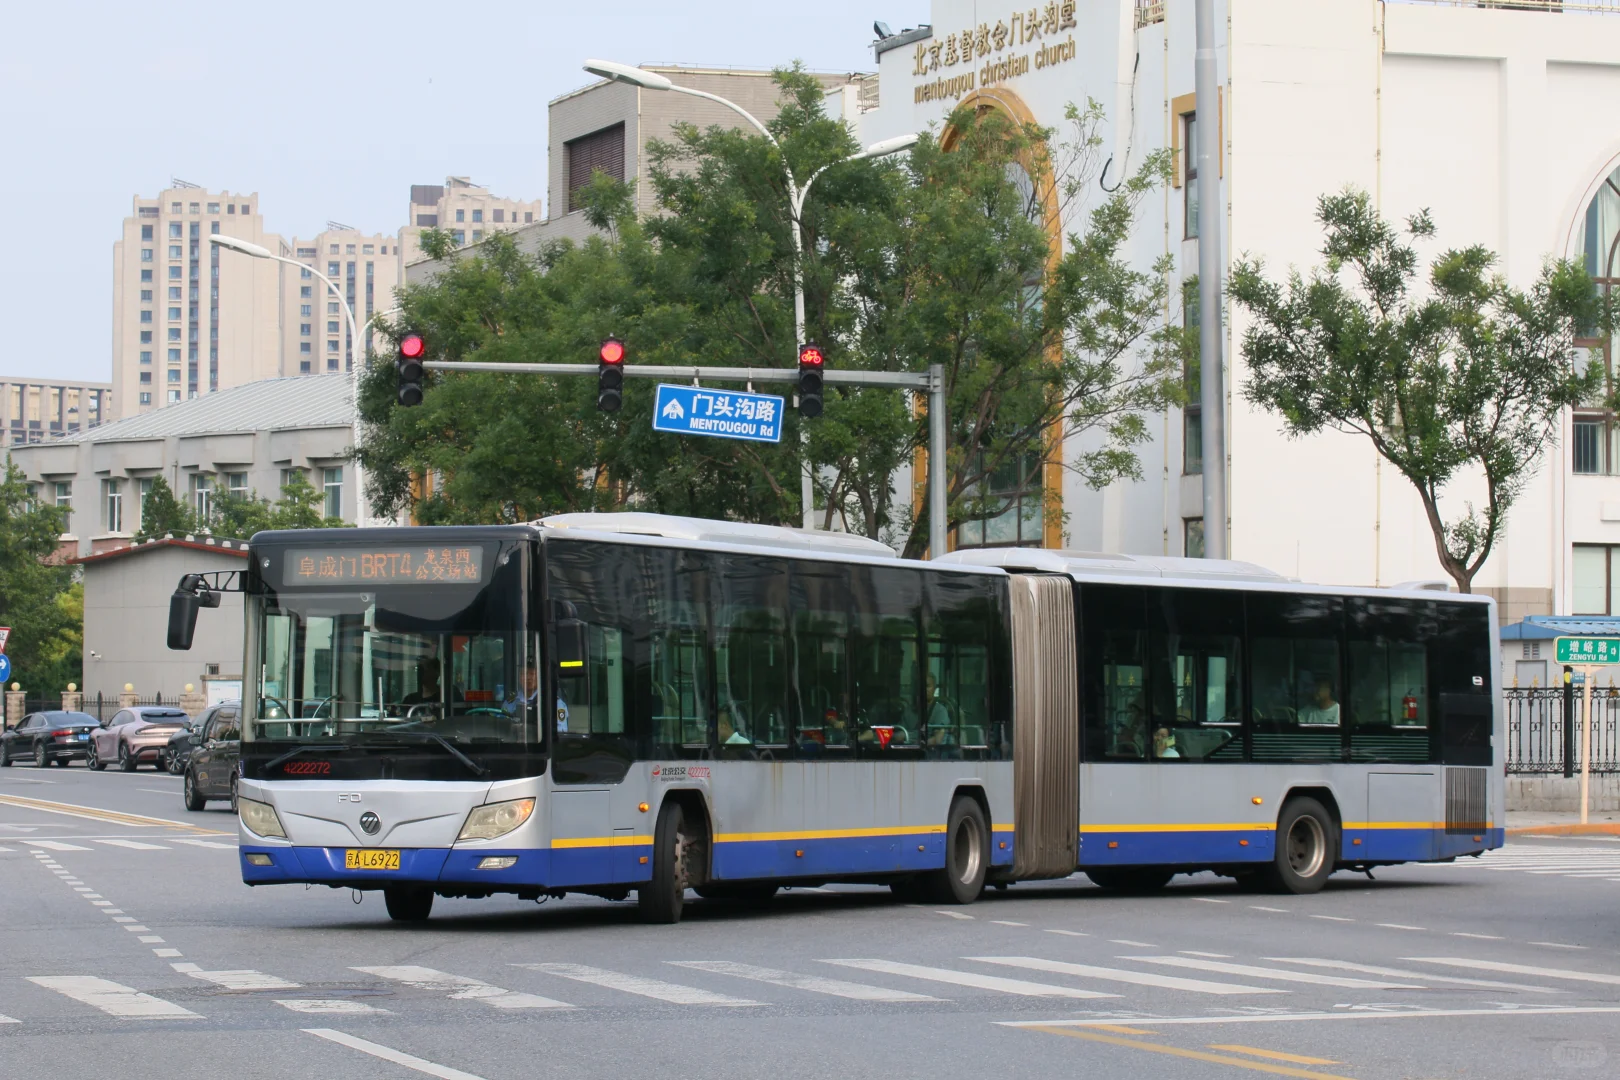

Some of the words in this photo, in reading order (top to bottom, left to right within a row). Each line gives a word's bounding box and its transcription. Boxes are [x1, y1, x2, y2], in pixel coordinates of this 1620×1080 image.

[912, 0, 1077, 76] 北京基督教会门头沟堂
[914, 71, 974, 103] mentougou
[979, 52, 1029, 86] christian
[1034, 34, 1076, 69] church
[691, 393, 775, 422] 门头沟路
[689, 417, 756, 435] MENTOUGOU
[759, 425, 774, 437] Rd
[424, 548, 471, 564] 龙泉西
[298, 556, 357, 578] 阜成门
[361, 553, 411, 578] BRT4
[415, 564, 478, 580] 公交场站
[1569, 640, 1607, 653] 增峪路
[1568, 653, 1596, 661] ZENGYU
[283, 761, 331, 774] 4222272
[661, 767, 686, 776] 北京公交
